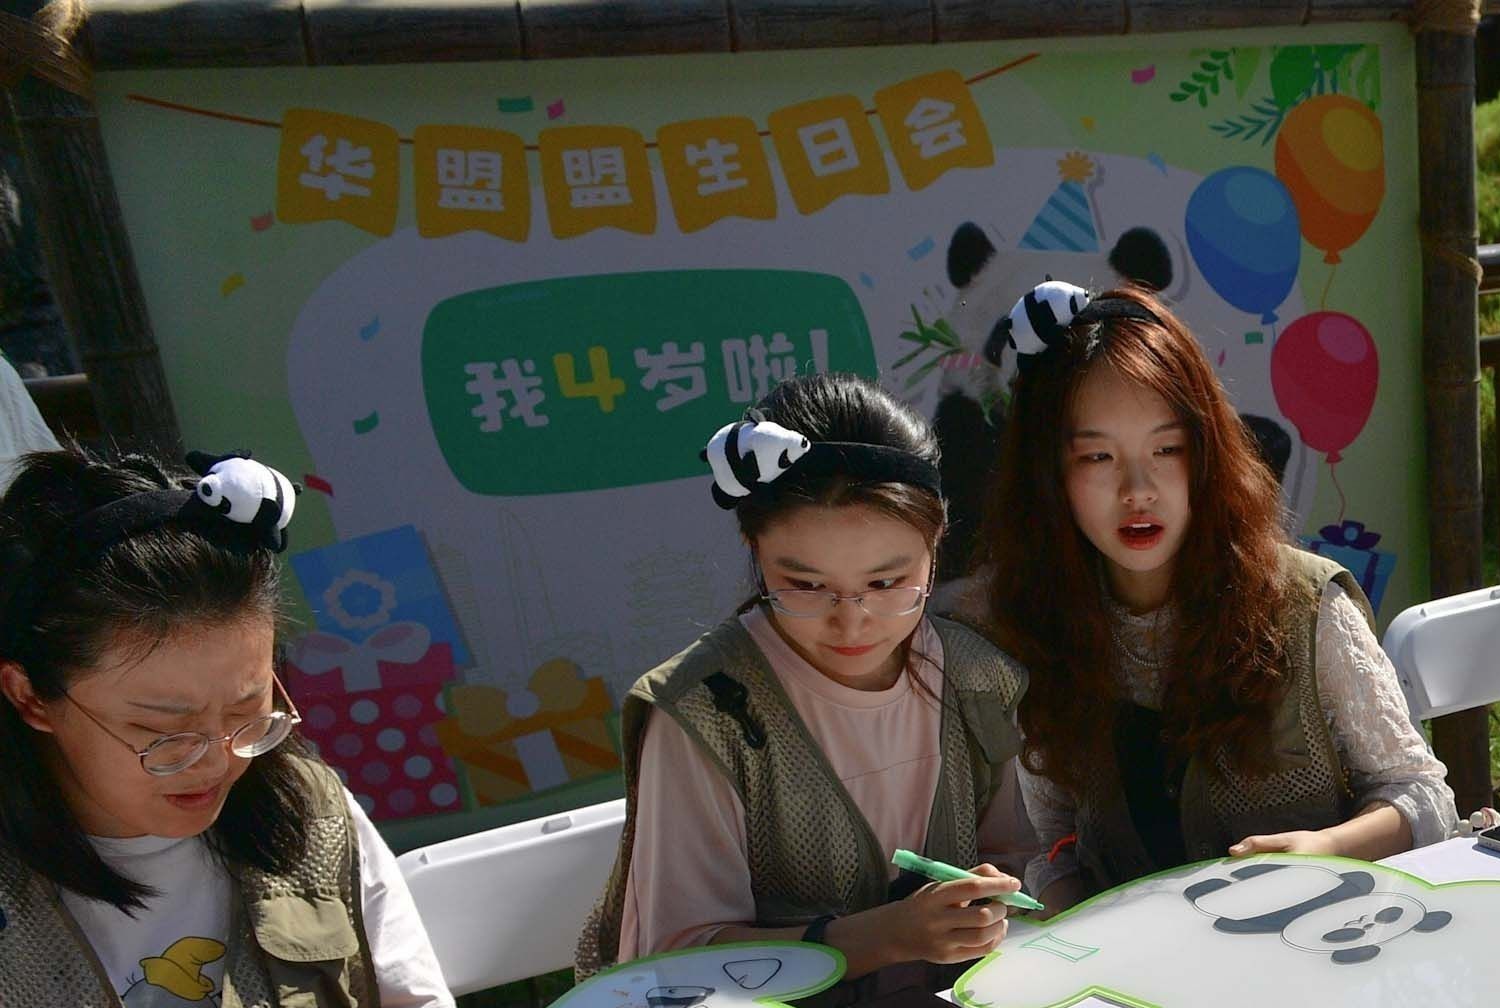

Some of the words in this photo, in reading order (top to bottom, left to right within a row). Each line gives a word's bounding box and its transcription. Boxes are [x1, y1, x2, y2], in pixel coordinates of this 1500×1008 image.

[299, 96, 967, 210] 华盟盟生日会
